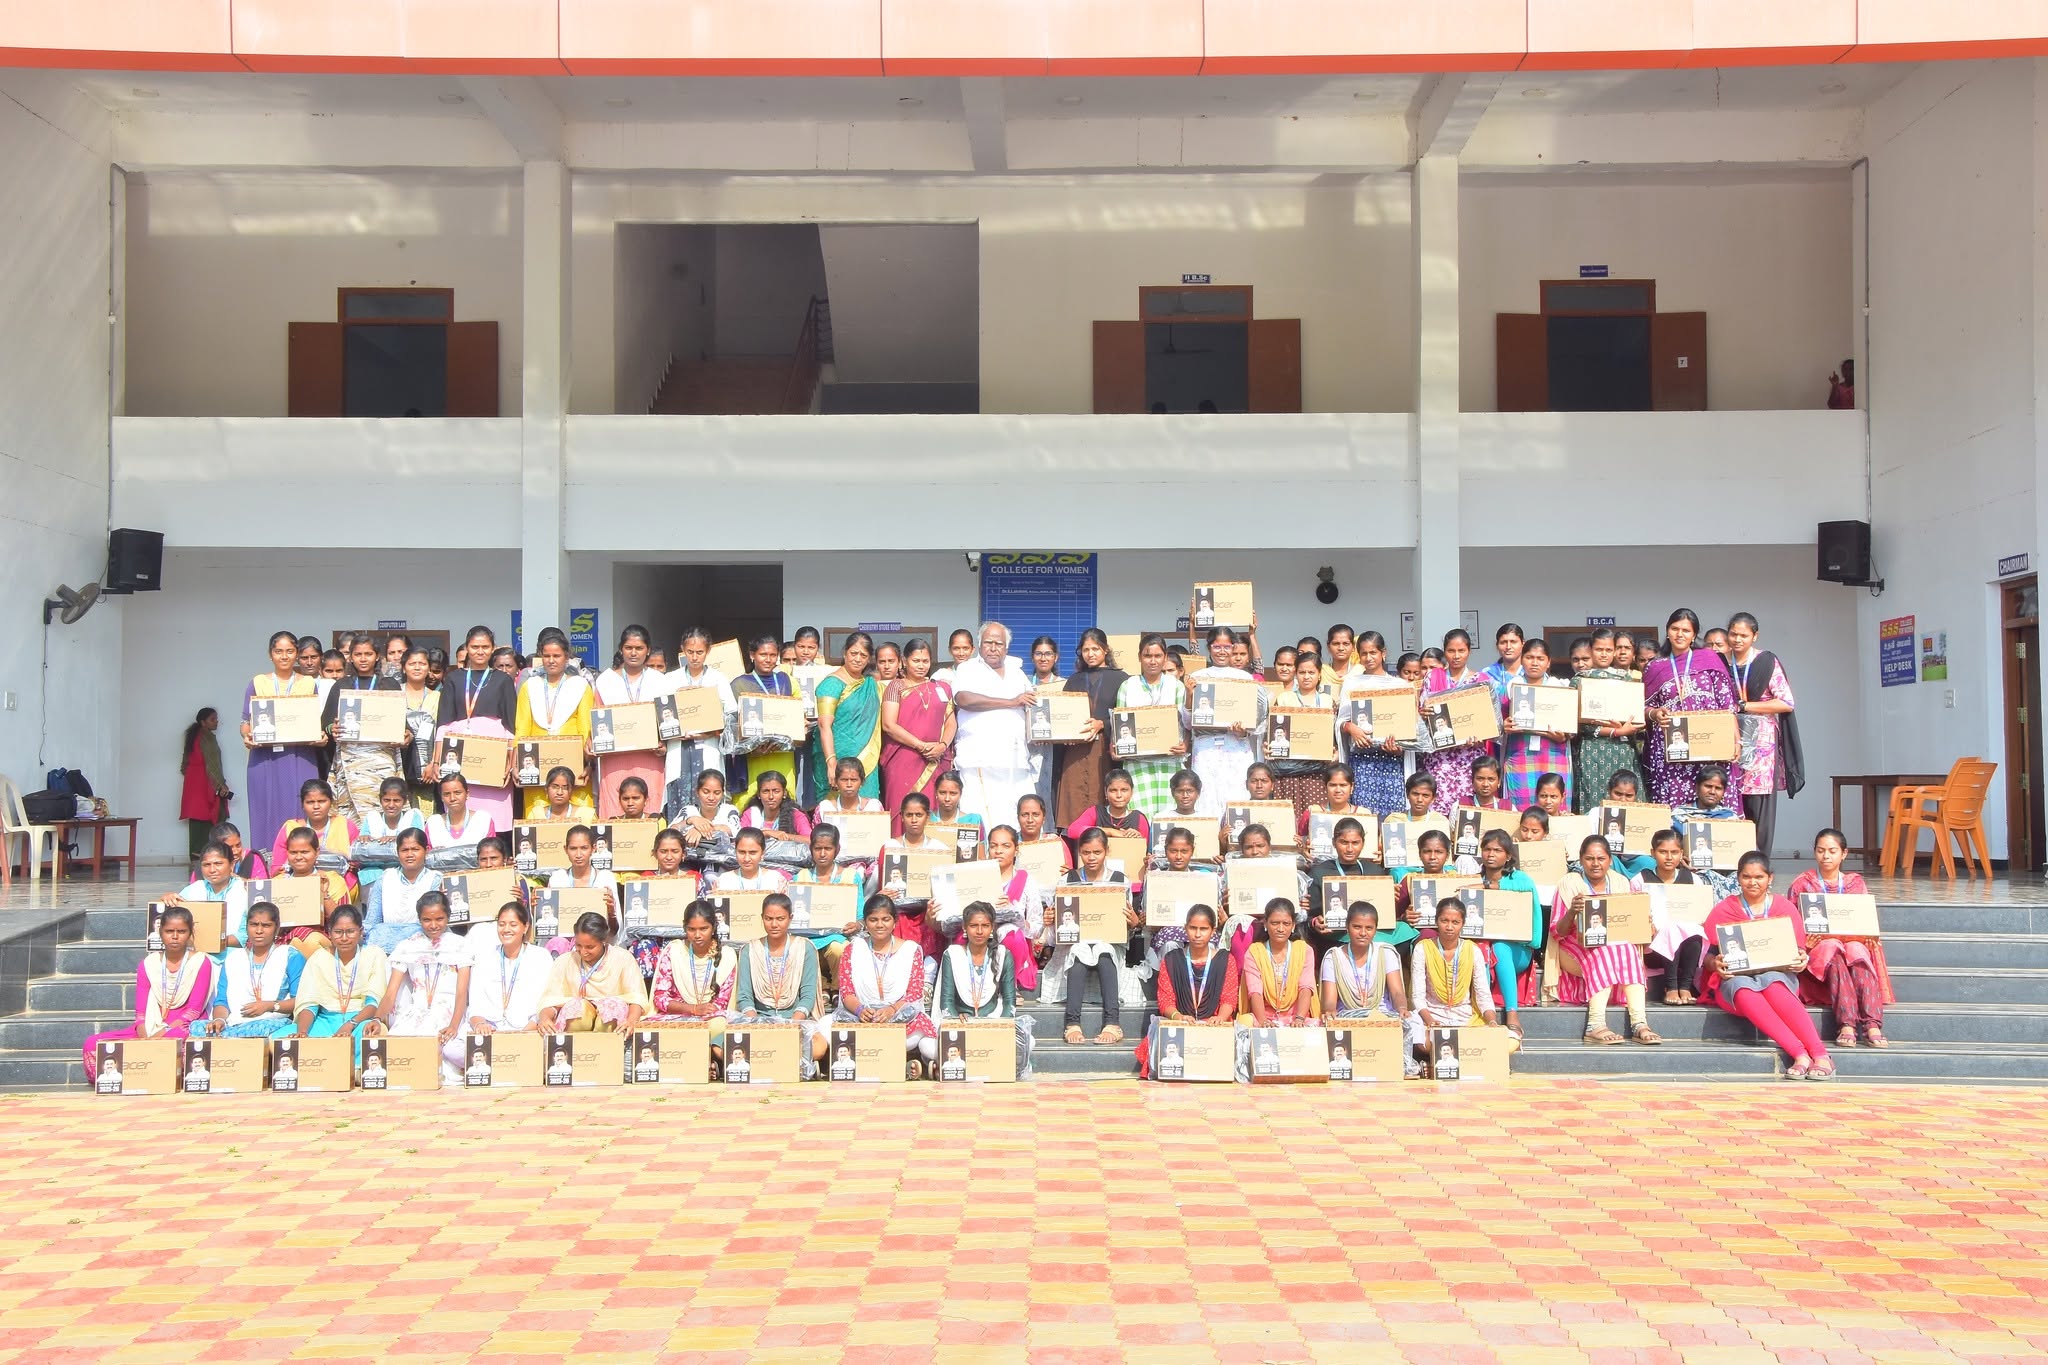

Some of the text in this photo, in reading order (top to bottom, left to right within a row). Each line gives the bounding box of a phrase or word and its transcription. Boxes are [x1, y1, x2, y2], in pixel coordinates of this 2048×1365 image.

[1999, 556, 2028, 574] CHAIRMAN
[991, 566, 1089, 574] COLLEGE FOR WOMEN
[1177, 620, 1189, 629] OFF
[1884, 660, 1912, 673] HELP DESK
[678, 705, 702, 714] acer
[1372, 712, 1397, 720] acer
[1451, 713, 1475, 724] acer
[614, 721, 638, 730] acer
[1136, 726, 1160, 735] acer
[1289, 731, 1315, 739] acer
[1689, 732, 1714, 740] acer
[462, 757, 486, 765] acer
[539, 757, 564, 765] acer
[536, 841, 563, 849] acer
[469, 889, 495, 899] acer
[1079, 912, 1106, 921] acer
[1483, 908, 1511, 917] acer
[1607, 914, 1632, 922] acer
[658, 1050, 686, 1059] acer
[749, 1050, 776, 1058] acer
[855, 1048, 883, 1057] acer
[966, 1049, 993, 1057] acer
[1351, 1048, 1380, 1057] acer
[1459, 1047, 1487, 1056] acer
[298, 1057, 327, 1067] acer
[387, 1057, 415, 1066] acer
[492, 1054, 520, 1063] acer
[573, 1053, 600, 1062] acer
[122, 1062, 153, 1071] acer
[210, 1058, 240, 1068] acer
